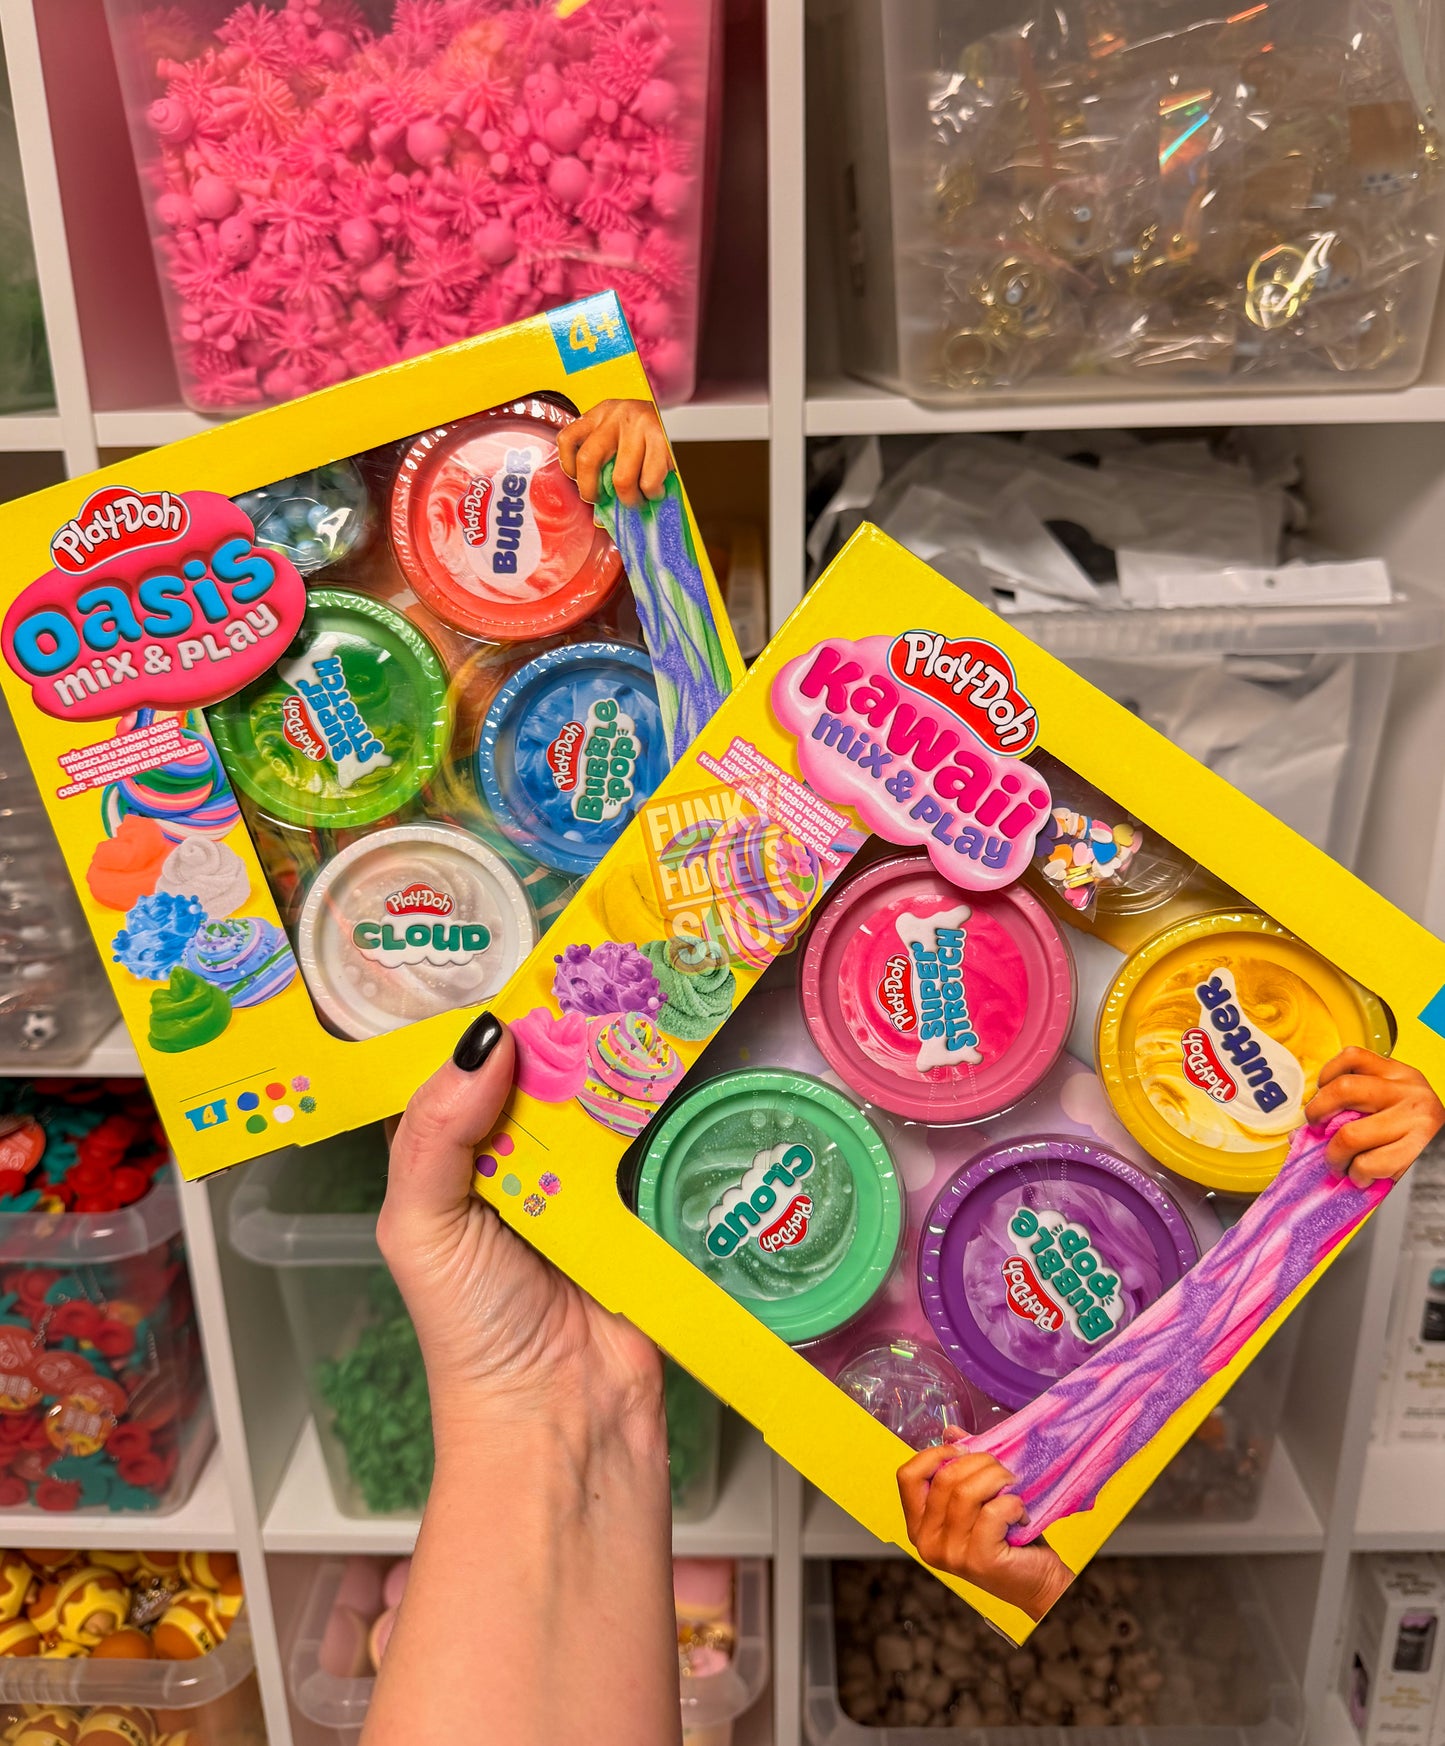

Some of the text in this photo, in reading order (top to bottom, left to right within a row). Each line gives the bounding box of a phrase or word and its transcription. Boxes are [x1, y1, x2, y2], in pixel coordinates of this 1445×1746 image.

[568, 312, 620, 353] 4+
[52, 491, 182, 566] Play-Doh
[463, 479, 490, 545] Play-Doh
[13, 538, 276, 678] oasis
[53, 651, 139, 707] mix
[144, 645, 173, 675] &
[902, 631, 1036, 747] Play-Doh
[149, 718, 179, 735] oasis
[149, 729, 179, 746] oasis
[282, 699, 323, 760] Play-Doh
[296, 680, 353, 761] SUPER
[73, 767, 99, 782] oasi
[553, 724, 582, 789] Play-Doh
[607, 737, 637, 801] POP
[811, 712, 893, 779] mix
[885, 769, 916, 803] &
[58, 782, 86, 798] oase
[387, 890, 450, 912] Play-Doh
[353, 922, 491, 952] CLOUD
[883, 957, 914, 1031] Play-Doh
[910, 942, 945, 1040] SUPER
[1181, 1032, 1231, 1101] Play-Doh
[202, 1105, 218, 1125] 4
[707, 1144, 814, 1257] CLOUD
[762, 1200, 813, 1253] Play-Doh
[1002, 1261, 1058, 1332] Play-Doh
[1059, 1229, 1119, 1299] POP
